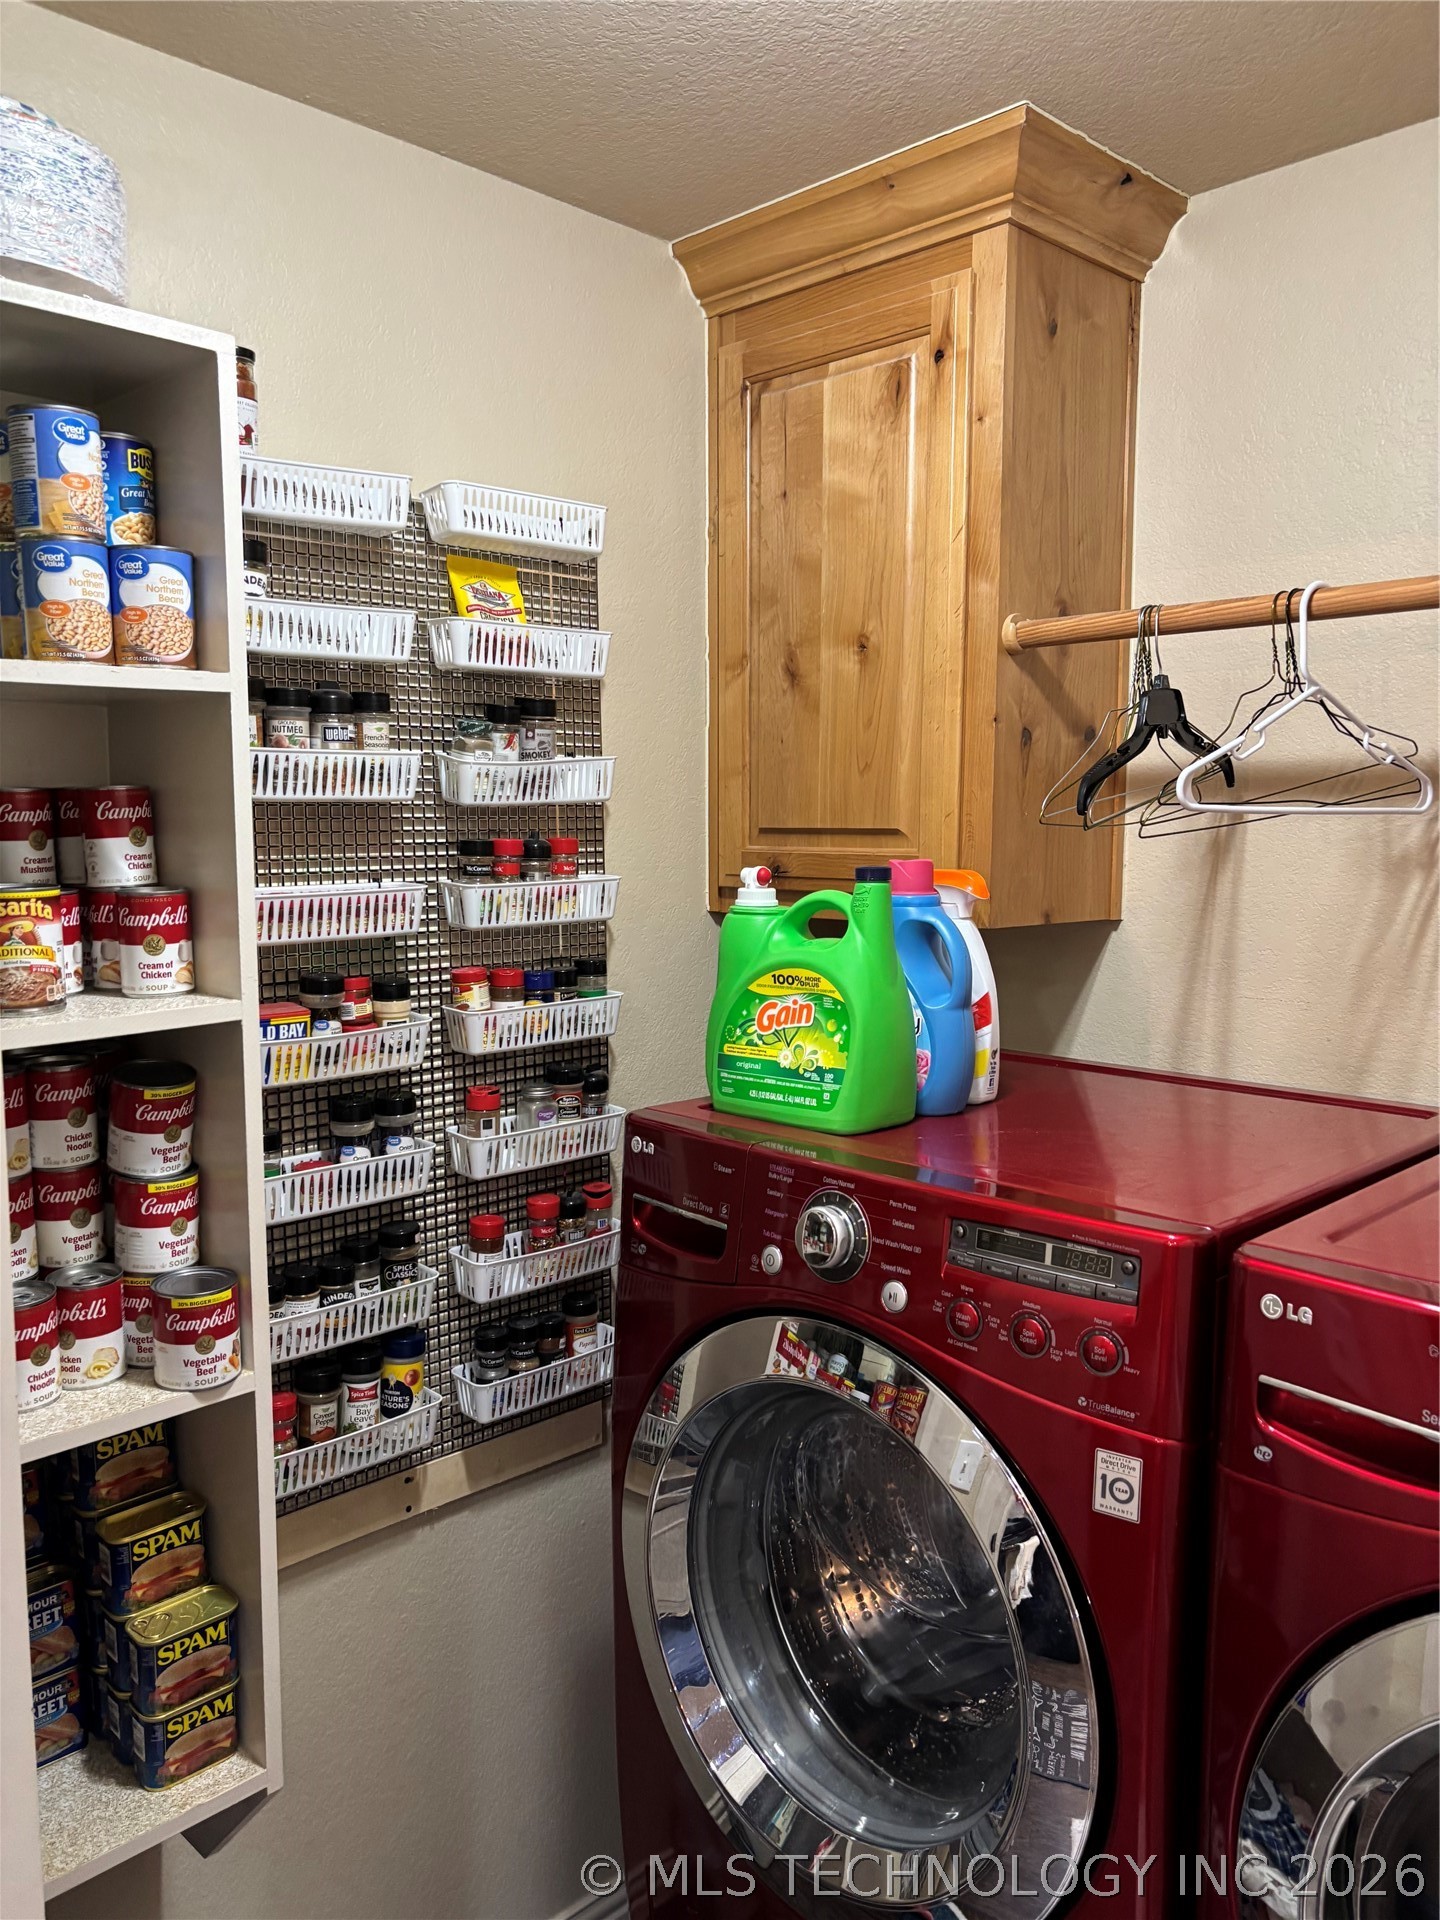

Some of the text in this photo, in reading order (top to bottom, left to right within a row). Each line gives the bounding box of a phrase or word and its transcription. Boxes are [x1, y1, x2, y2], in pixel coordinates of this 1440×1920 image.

[58, 422, 84, 434] Great
[65, 430, 86, 441] Value
[121, 488, 145, 498] Great
[37, 552, 64, 562] Great
[43, 560, 65, 568] Value
[118, 560, 142, 570] Great
[82, 570, 104, 579] Great
[69, 578, 104, 589] Northern
[160, 576, 183, 586] Great
[82, 588, 105, 598] Beans
[146, 584, 184, 596] Northern
[159, 594, 184, 603] Beans
[272, 725, 303, 734] NUTMEG
[520, 750, 550, 760] SMOKEY
[24, 856, 46, 864] Cream
[124, 853, 147, 861] Cream
[118, 905, 188, 930] Campbell's
[138, 962, 164, 970] Cream
[141, 971, 172, 979] Chicken
[772, 973, 805, 987] 100%
[756, 998, 814, 1033] Gain
[280, 1024, 305, 1039] BAY
[736, 1061, 762, 1070] original
[65, 1132, 93, 1143] Chicken
[67, 1141, 92, 1152] Noodle
[151, 1142, 188, 1156] Vegetable
[643, 1140, 654, 1155] LG
[71, 1154, 90, 1163] SOUP
[163, 1154, 180, 1164] Beef
[160, 1164, 181, 1173] SOUP
[768, 1172, 792, 1183] Bulky/Large
[823, 1176, 855, 1189] Cotton/Normal
[166, 1182, 186, 1190] BIGGER
[767, 1188, 784, 1199] Sanitary
[683, 1196, 713, 1214] Direct Drive
[903, 1203, 917, 1212] Press
[892, 1219, 915, 1230] Delicates
[62, 1230, 99, 1244] Vegetable
[158, 1234, 195, 1250] Vegetable
[74, 1241, 92, 1252] Beef
[872, 1236, 913, 1252] Hand Wash/Wool
[171, 1246, 188, 1258] Beef
[73, 1254, 94, 1263] SOUP
[169, 1257, 189, 1268] SOUP
[386, 1268, 418, 1280] CLASSICS
[393, 1264, 413, 1273] SPICE
[881, 1262, 911, 1275] Speed Wash
[1022, 1300, 1041, 1310] Medium
[165, 1302, 236, 1334] Campbell's
[956, 1312, 970, 1321] Wash
[988, 1315, 1000, 1324] Extra
[1286, 1303, 1313, 1325] LG
[956, 1319, 969, 1328] Temp
[1094, 1317, 1112, 1326] Normal
[1022, 1328, 1034, 1337] Spin
[1020, 1335, 1037, 1345] Speed
[1050, 1348, 1063, 1356] Extra
[1065, 1349, 1077, 1357] Light
[1094, 1346, 1105, 1355] Soil
[183, 1353, 227, 1368] Vegetable
[1050, 1354, 1062, 1362] High
[1091, 1353, 1107, 1362] Level
[27, 1368, 55, 1384] Chicken
[196, 1365, 217, 1376] Beef
[1124, 1366, 1140, 1376] Heavy
[30, 1377, 55, 1392] Noodle
[194, 1376, 219, 1387] SOUP
[34, 1391, 54, 1404] SOUP
[356, 1408, 371, 1418] Bay
[96, 1422, 164, 1460] SPAM
[1101, 1458, 1136, 1472] Direct Drive
[1106, 1455, 1131, 1464] INVERTER
[1100, 1473, 1134, 1504] 10
[1115, 1487, 1128, 1495] YEAR
[1100, 1503, 1133, 1517] WARRANTY
[132, 1520, 201, 1562] SPAM
[157, 1619, 226, 1667] SPAM
[166, 1692, 234, 1740] SPAM
